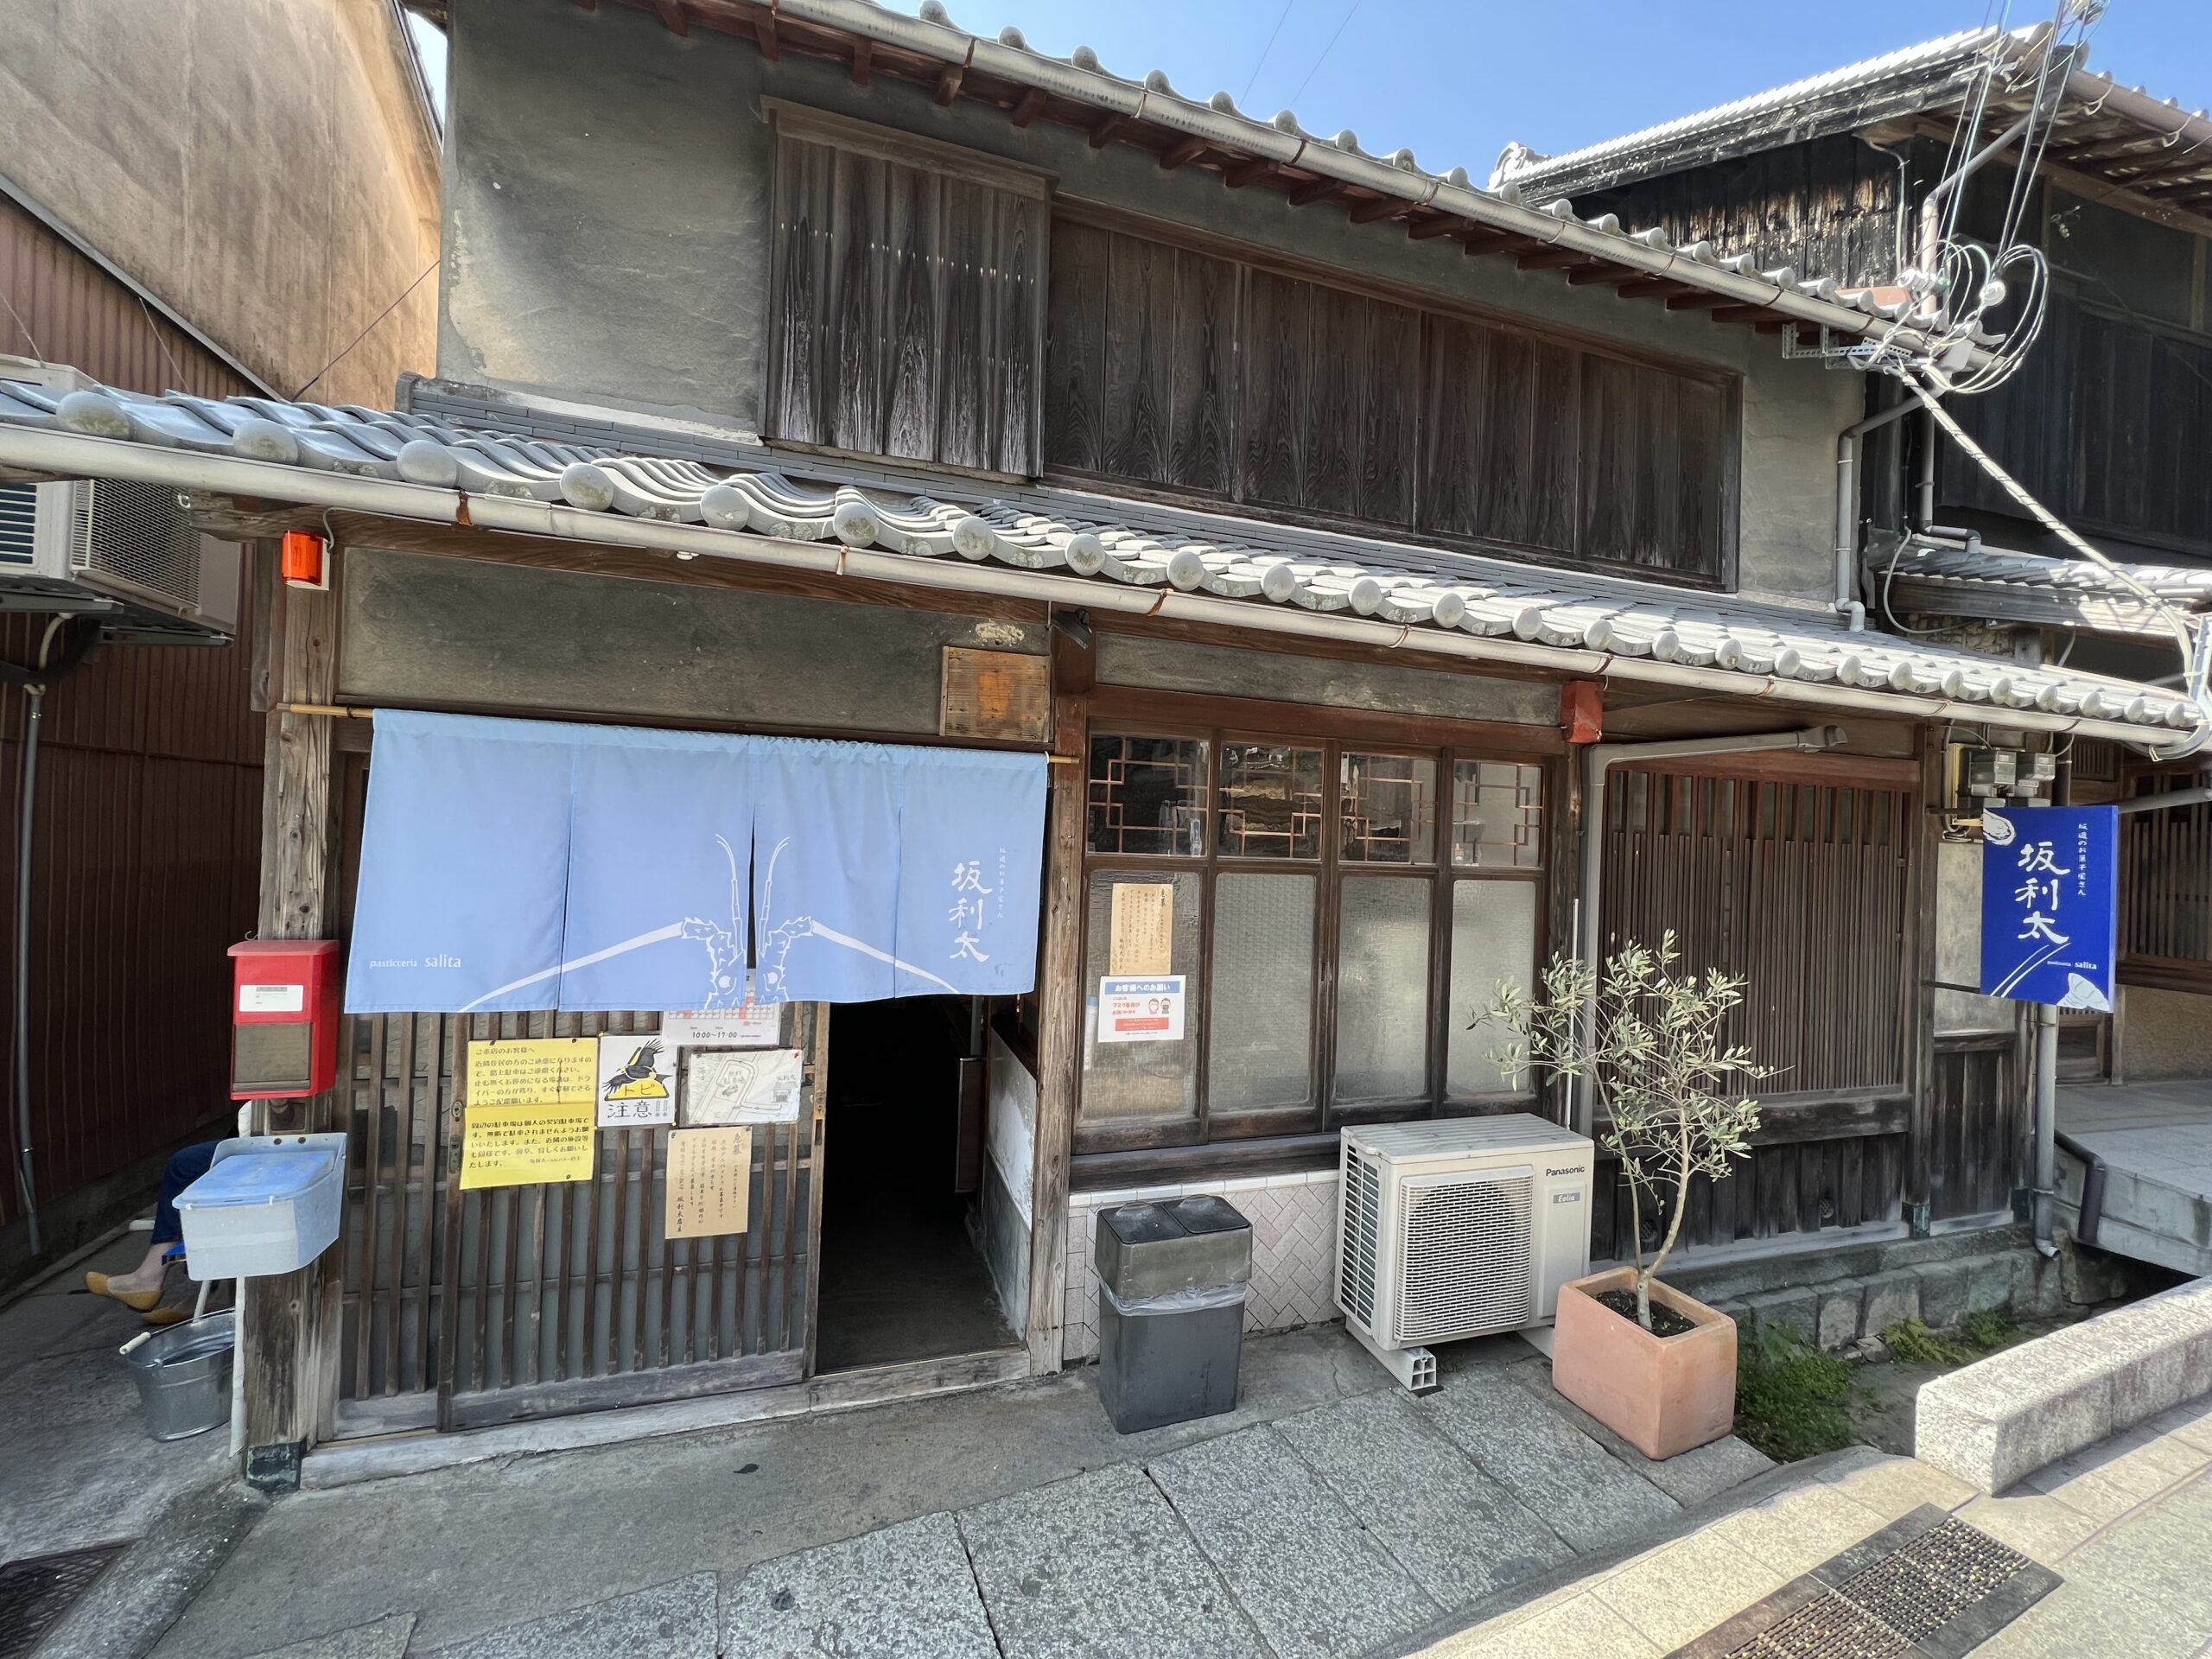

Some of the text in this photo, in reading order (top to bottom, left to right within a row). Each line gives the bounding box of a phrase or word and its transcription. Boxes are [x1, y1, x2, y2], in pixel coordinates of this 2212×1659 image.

[2015, 841, 2071, 944] 坂利太
[949, 861, 993, 963] 坂利太
[369, 953, 461, 969] pasticceria salita
[2074, 961, 2097, 969] salita
[625, 1084, 655, 1096] トビ
[1546, 1165, 1585, 1176] Panasonic
